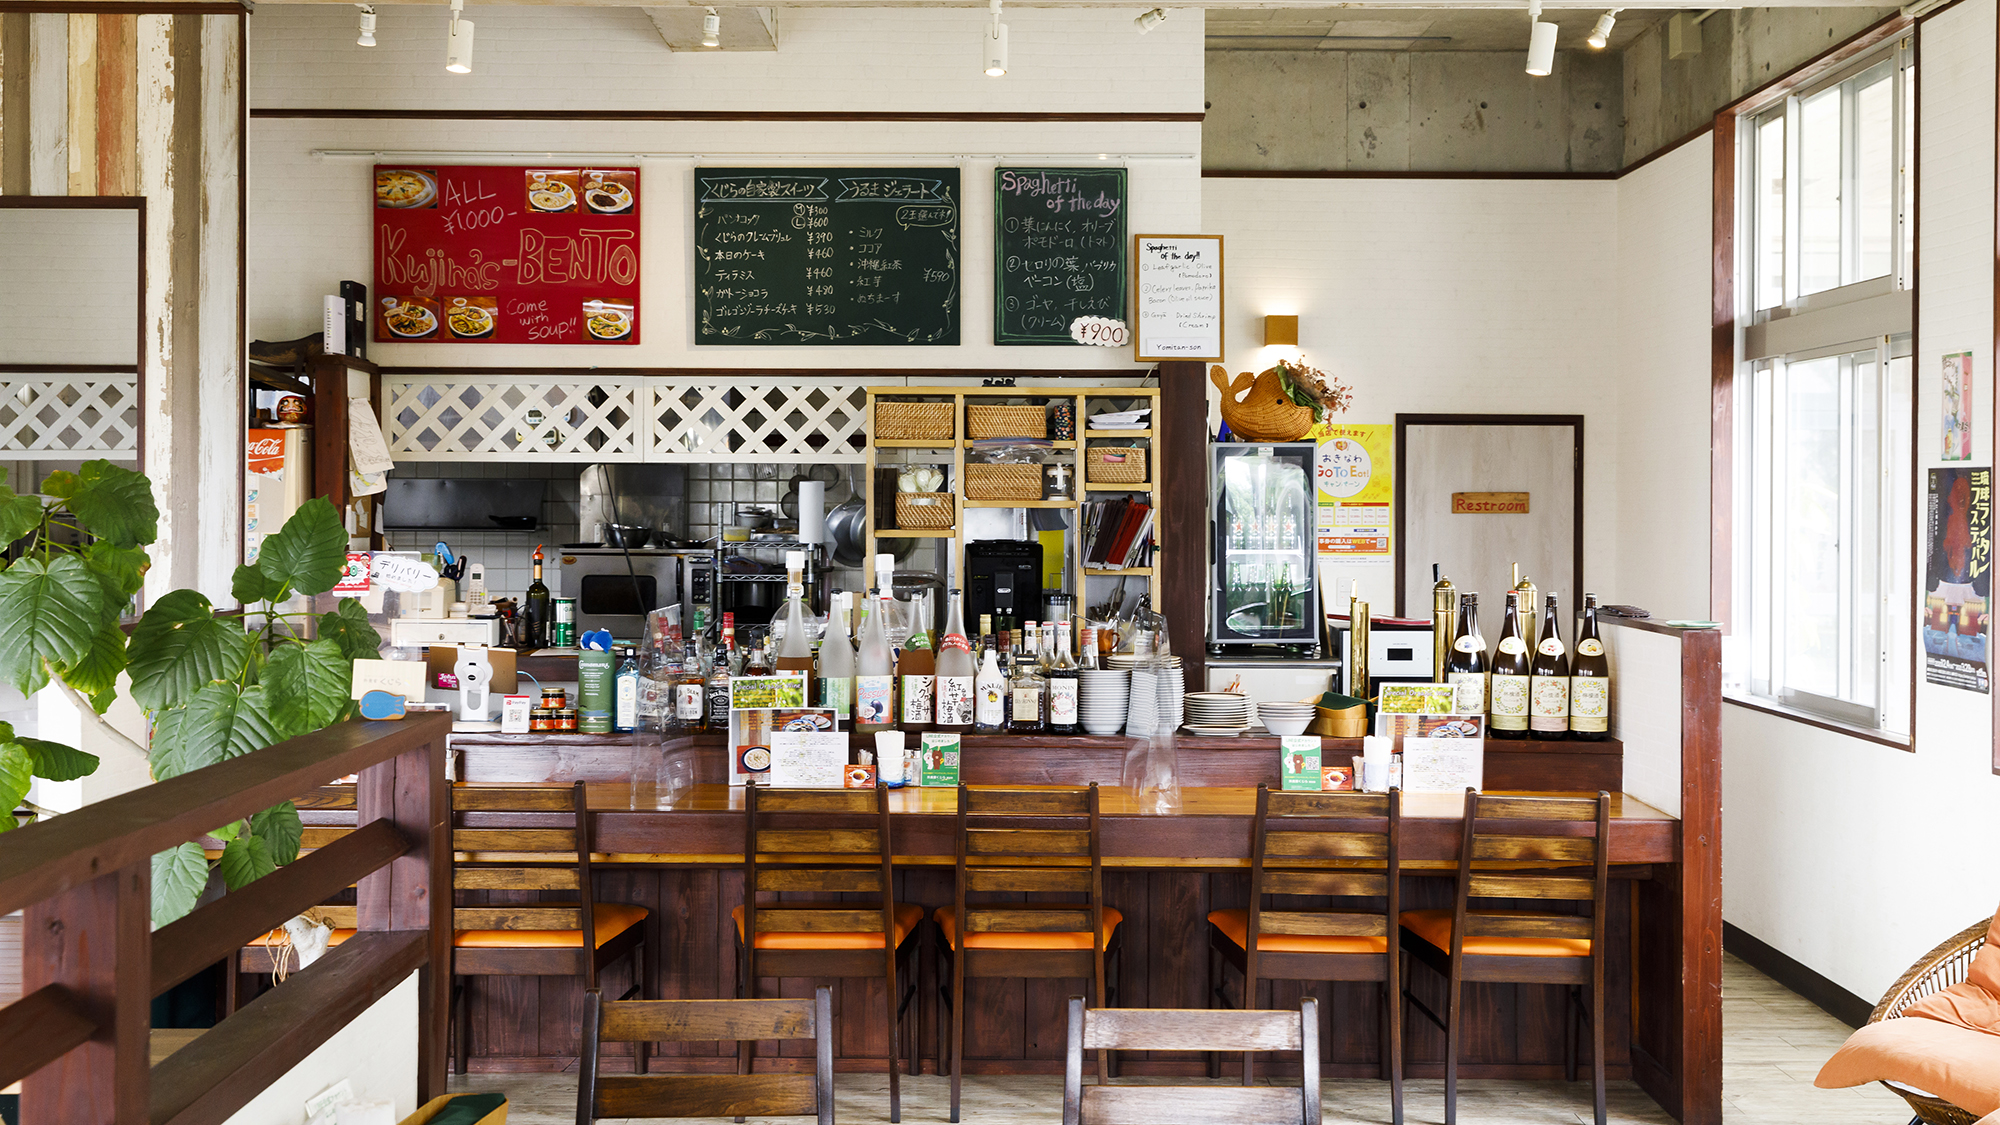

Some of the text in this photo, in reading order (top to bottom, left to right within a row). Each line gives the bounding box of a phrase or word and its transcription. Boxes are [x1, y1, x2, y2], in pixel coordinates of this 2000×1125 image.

[711, 179, 815, 199] くじらの自家製スイーツ
[1002, 171, 1078, 197] Spaghetti
[444, 179, 497, 207] ALL
[1046, 190, 1120, 218] of the day
[807, 216, 829, 229] ¥600
[807, 231, 833, 245] ¥390
[859, 227, 883, 239] ミルク
[715, 246, 835, 261] 本日のケーキ ¥460
[858, 243, 882, 255] ココア
[1160, 252, 1168, 260] of
[1171, 252, 1181, 260] the
[715, 266, 833, 282] ティラミス ¥460
[923, 268, 950, 282] ¥590
[716, 287, 769, 300] ガトーショコラ
[506, 299, 548, 315] Come
[715, 302, 836, 317] ゴルゴンゾーラチーズケーキ ¥530
[519, 313, 549, 326] with
[1080, 323, 1124, 343] ¥900
[1322, 454, 1362, 463] おきなわ
[1456, 498, 1526, 511] Restroom
[380, 560, 431, 579] デリバリー
[858, 687, 889, 700] Passion
